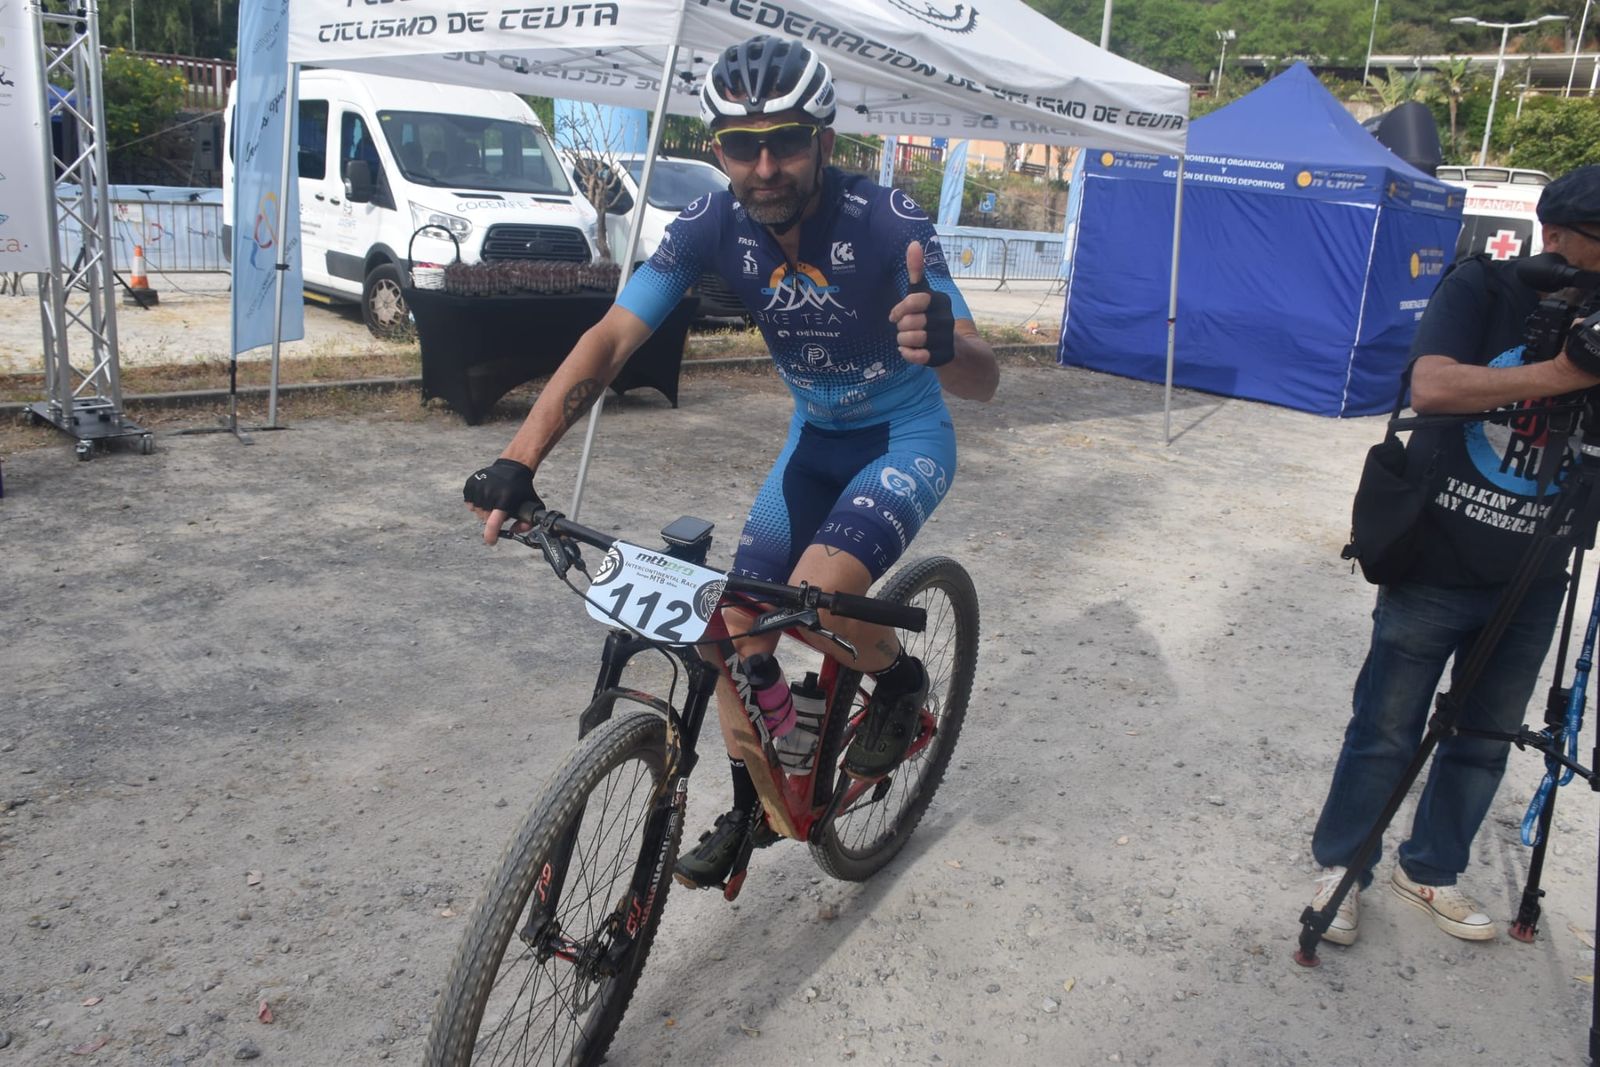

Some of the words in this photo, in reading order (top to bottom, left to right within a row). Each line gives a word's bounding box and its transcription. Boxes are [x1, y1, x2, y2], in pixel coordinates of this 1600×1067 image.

[318, 15, 438, 43] CICLISMO
[447, 11, 488, 35] DE
[499, 2, 619, 30] CEUTA
[1092, 104, 1119, 125] DE
[1125, 109, 1184, 130] CEUTA
[1227, 158, 1285, 171] ORGANIZACIÓN
[1163, 169, 1194, 181] GESÓN
[1194, 172, 1204, 181] DE
[1205, 174, 1238, 185] EVENTOS
[1239, 179, 1286, 190] DEPORTIVOS
[801, 309, 858, 325] TEAM
[1435, 491, 1462, 512] MY
[1447, 476, 1517, 511] TALKIN'
[635, 552, 695, 577] mtbpro
[609, 582, 693, 643] 112
